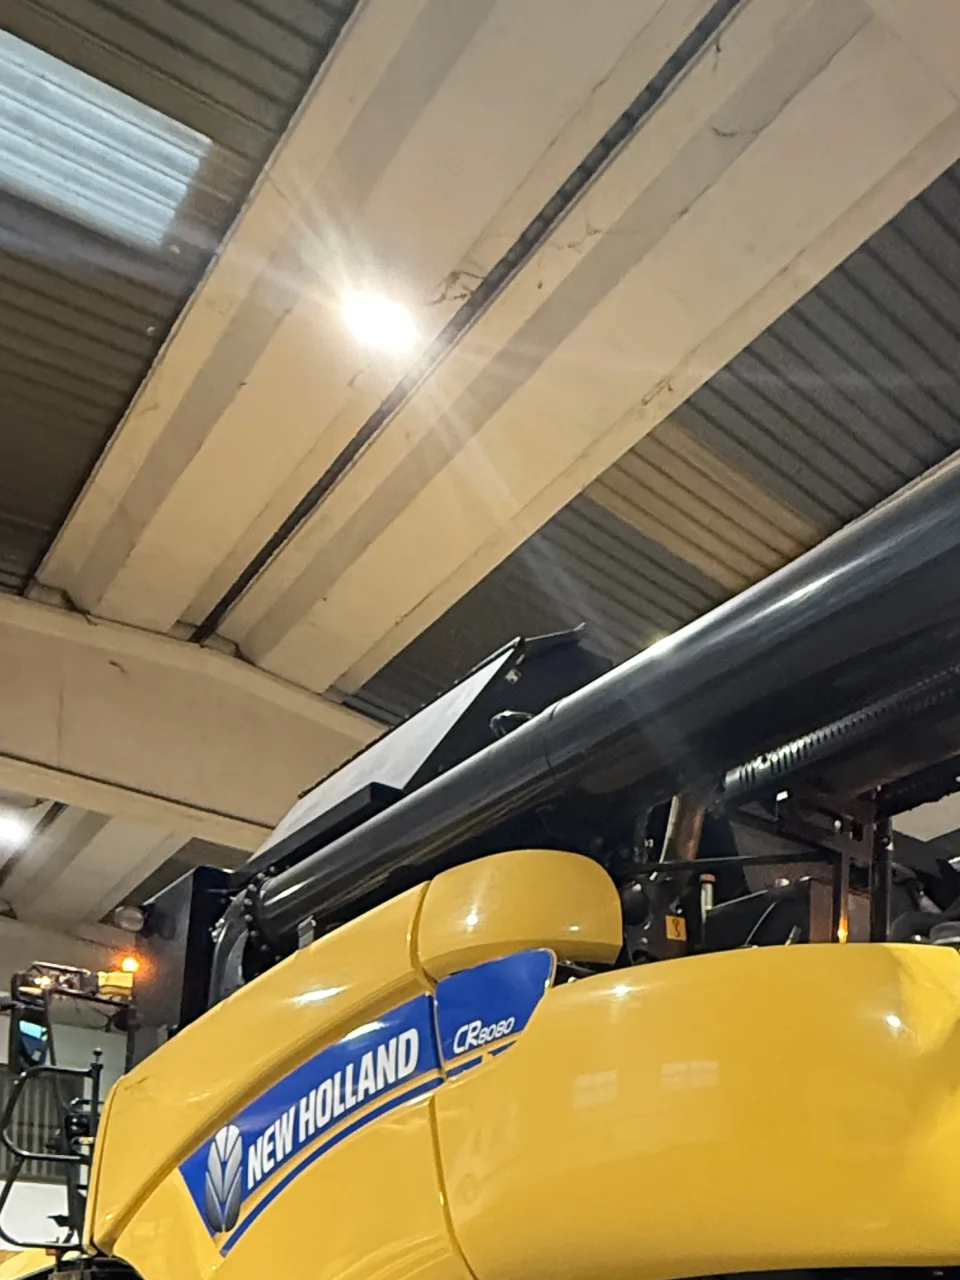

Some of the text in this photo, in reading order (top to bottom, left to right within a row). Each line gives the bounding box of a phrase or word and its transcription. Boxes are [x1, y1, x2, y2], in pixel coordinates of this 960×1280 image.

[453, 1016, 515, 1054] CR8080
[247, 1028, 419, 1190] NEW HOLLAND
